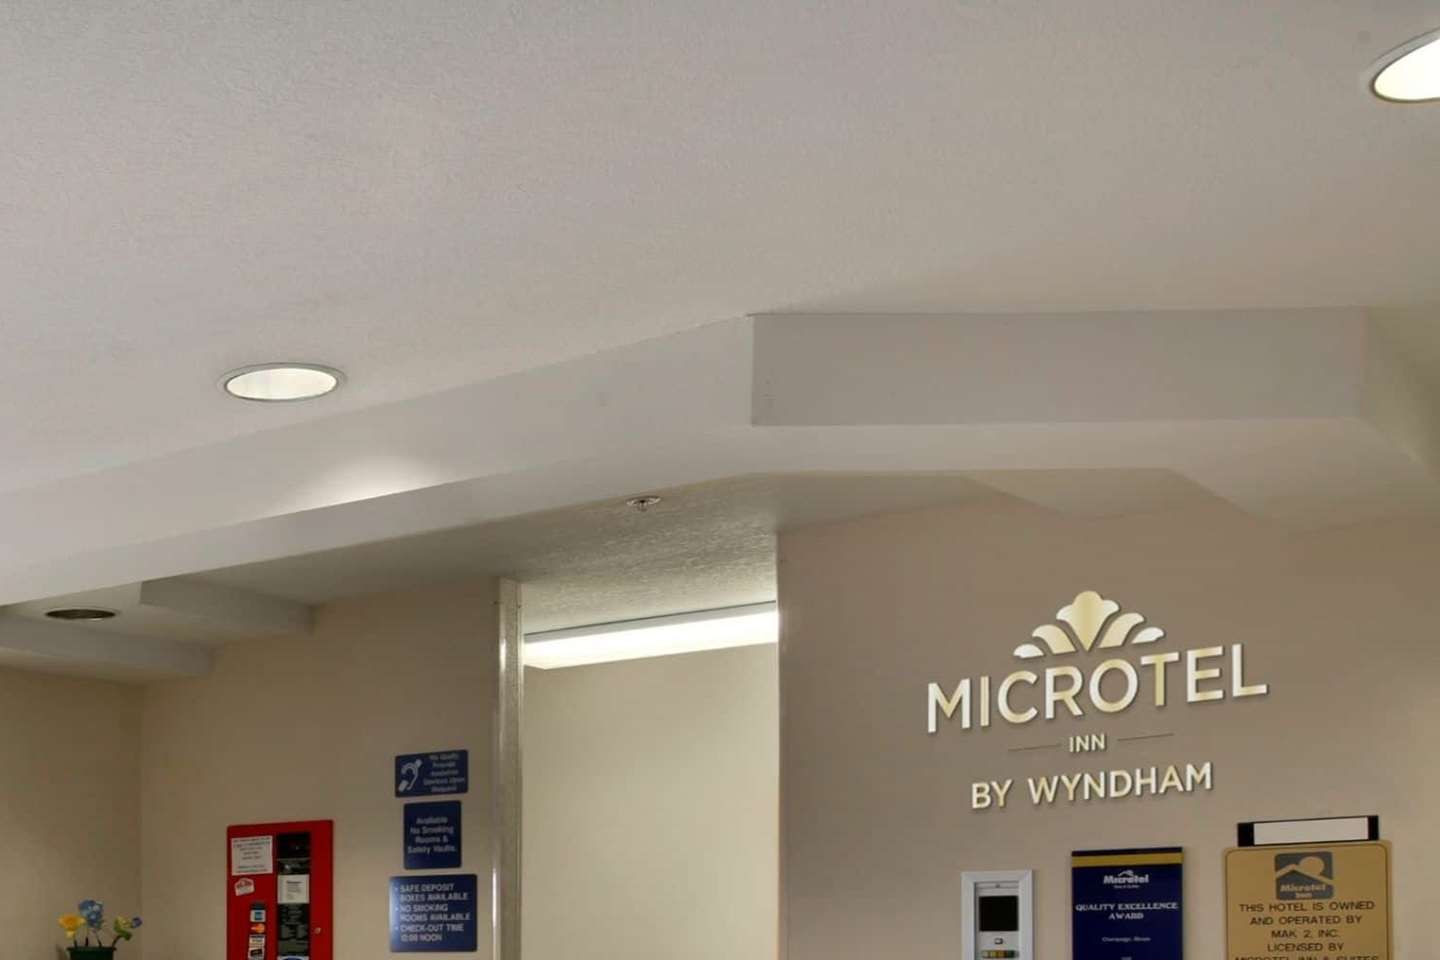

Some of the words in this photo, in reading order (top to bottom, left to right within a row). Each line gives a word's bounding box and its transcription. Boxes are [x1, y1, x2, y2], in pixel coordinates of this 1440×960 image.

[927, 643, 1268, 733] MICROTEL
[1068, 734, 1106, 753] INN
[971, 779, 1012, 809] BY
[1027, 762, 1213, 805] WYNDHAM
[1075, 903, 1116, 912] QUALITY
[1118, 902, 1178, 911] EXCELLENCE
[1239, 903, 1264, 912] THIS
[1269, 902, 1307, 912] HOTEL
[1312, 902, 1324, 911] IS
[1329, 900, 1375, 911] OWNED
[1109, 912, 1144, 920] AWARD
[1250, 916, 1273, 925] AND
[1279, 915, 1342, 925] OPERATED
[1346, 915, 1363, 924] BY
[1271, 930, 1297, 938] MAK
[1267, 942, 1323, 952] LICENSED
[1328, 942, 1344, 951] BY
